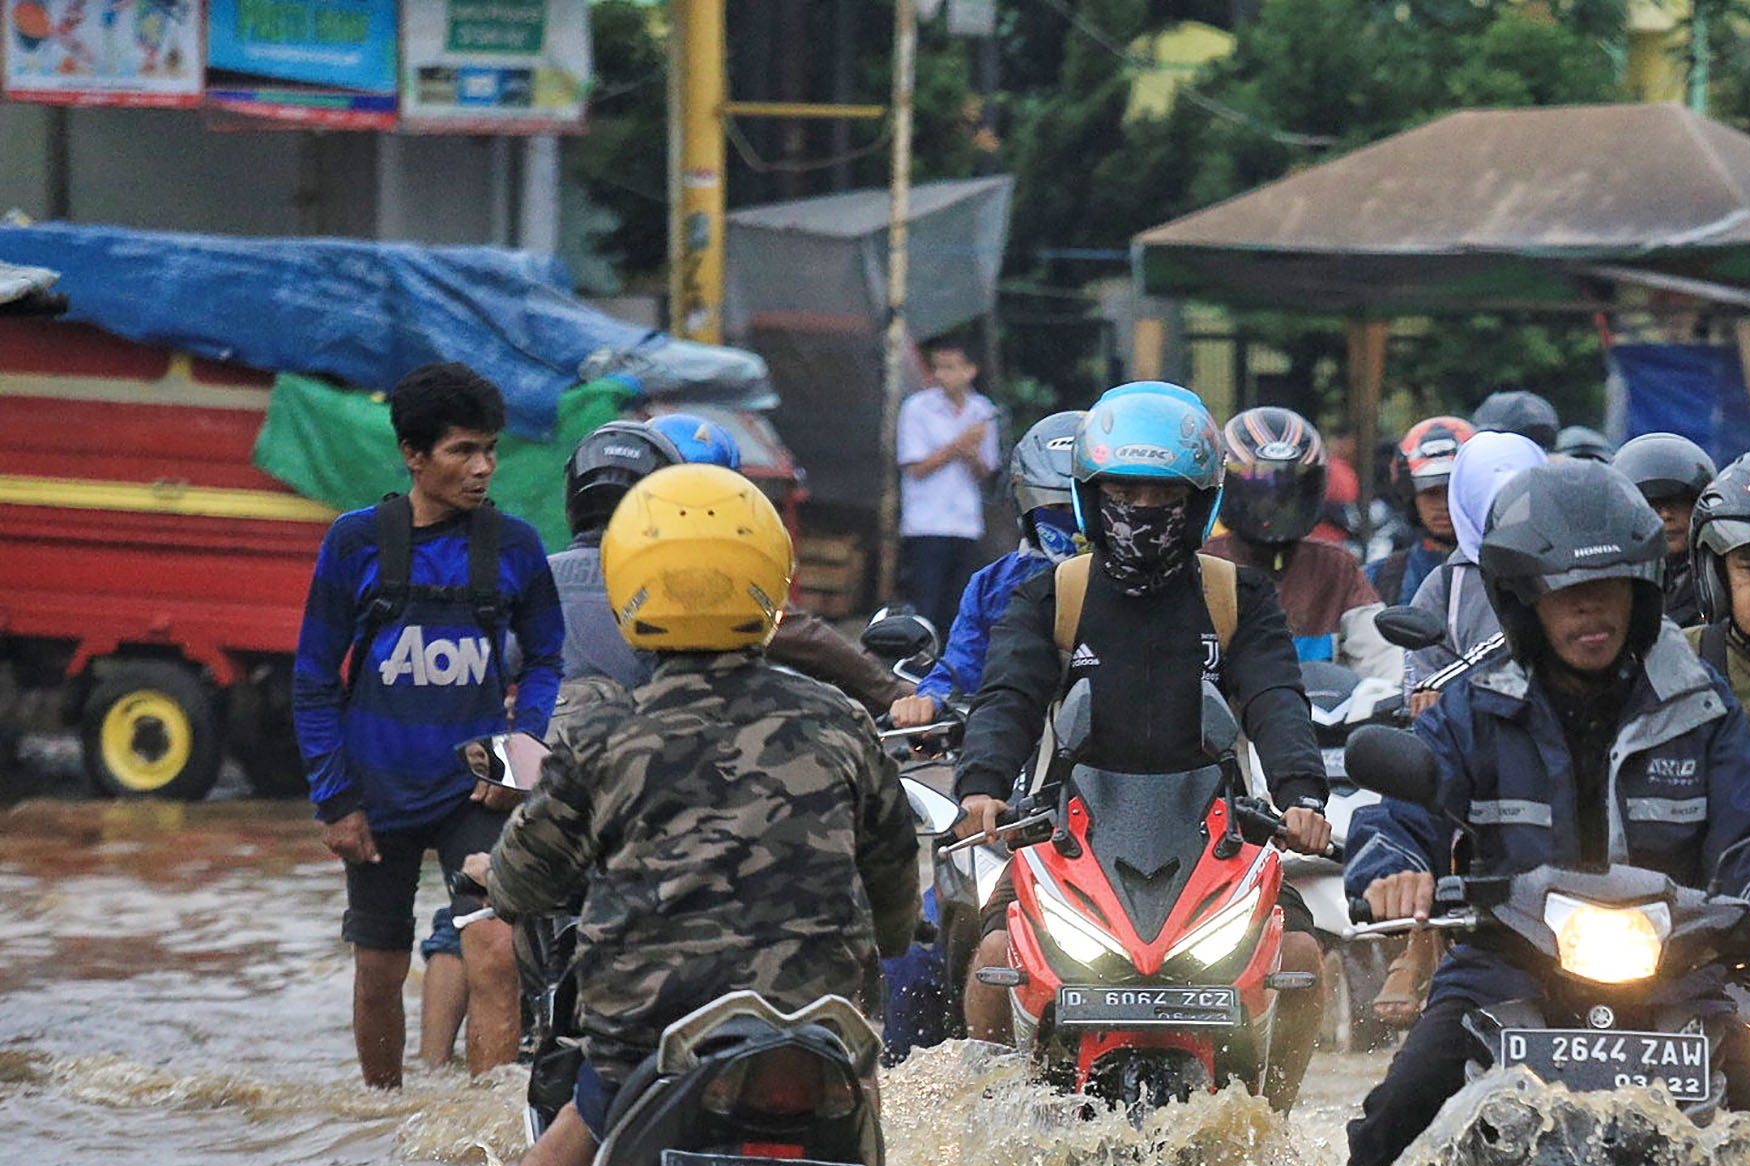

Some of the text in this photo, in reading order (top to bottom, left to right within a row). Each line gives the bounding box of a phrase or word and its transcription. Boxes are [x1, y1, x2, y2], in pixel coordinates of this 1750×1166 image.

[1574, 544, 1621, 558] HONDA
[1068, 992, 1081, 1006] D
[1510, 1035, 1702, 1067] D 2644 ZAW
